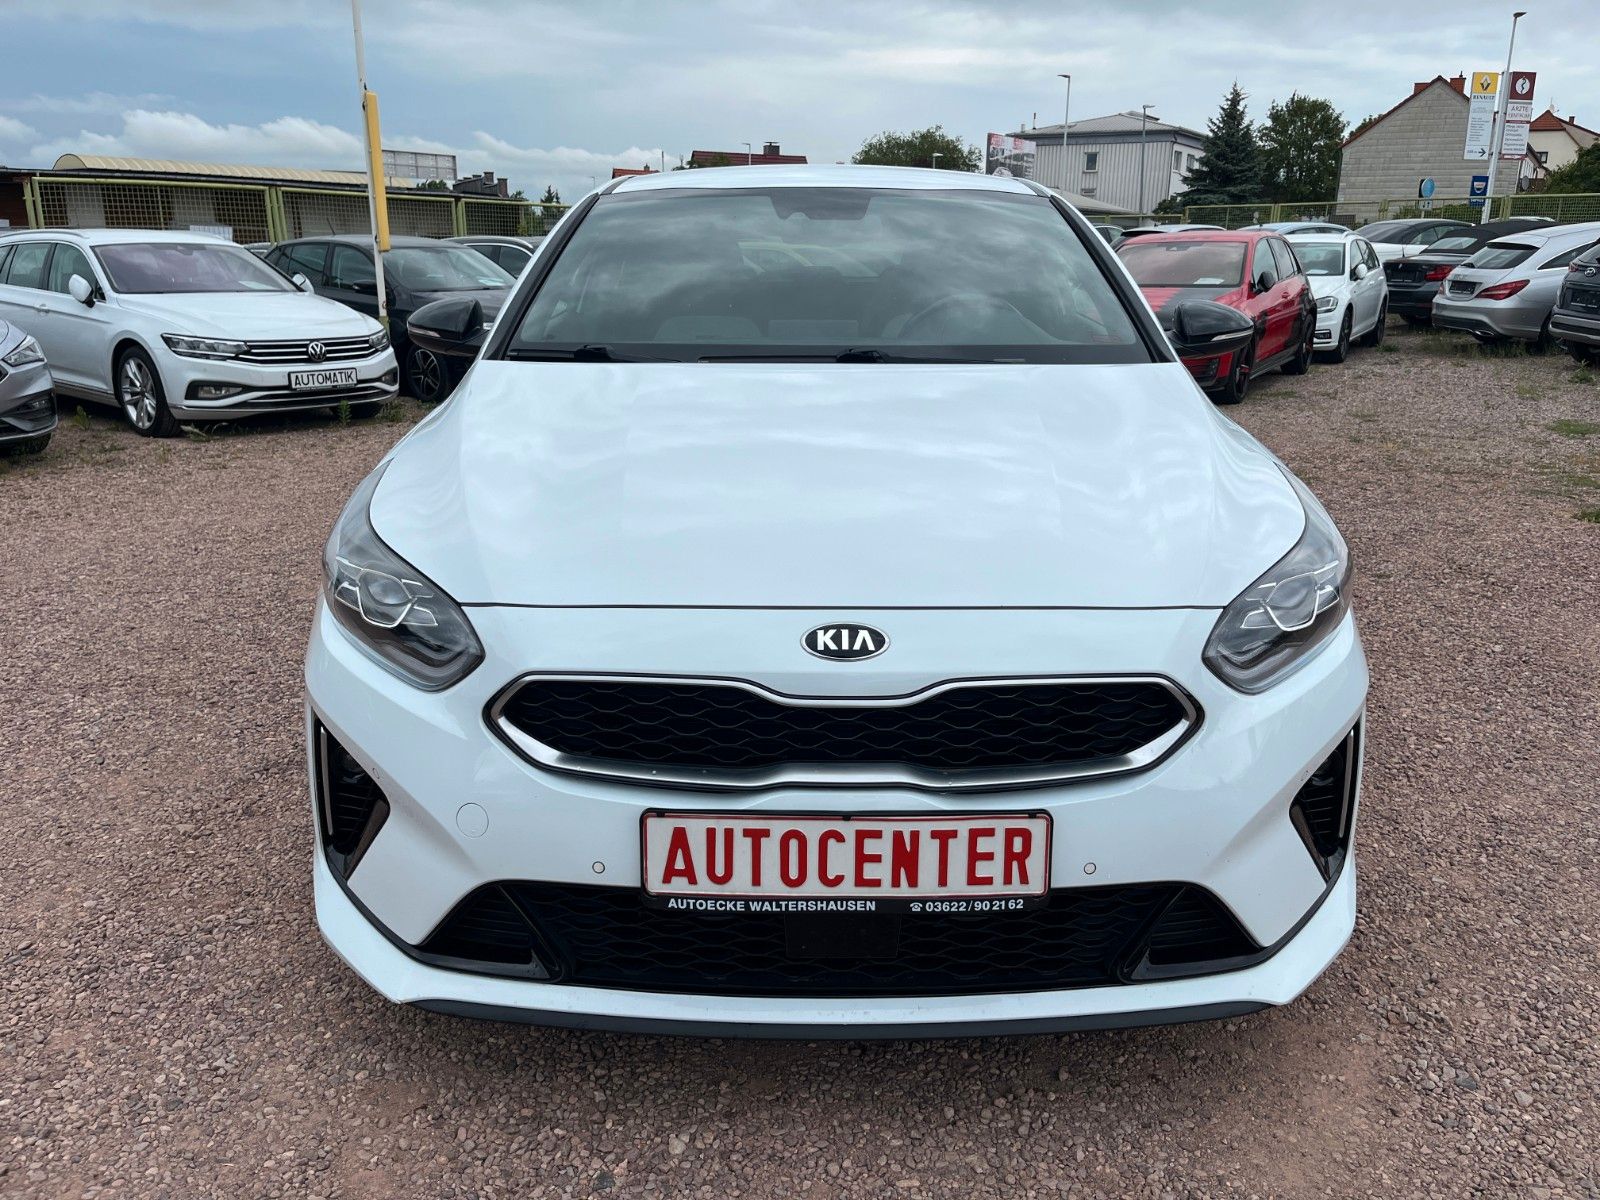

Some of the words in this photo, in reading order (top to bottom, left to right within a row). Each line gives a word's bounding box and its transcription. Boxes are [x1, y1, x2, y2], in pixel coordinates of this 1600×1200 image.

[295, 371, 354, 386] AUTOMATIK
[815, 628, 876, 651] KIA
[661, 826, 1033, 889] AUTOCENTER
[667, 897, 746, 911] AUTOECKE
[748, 899, 877, 912] WALTERSHAUSEN
